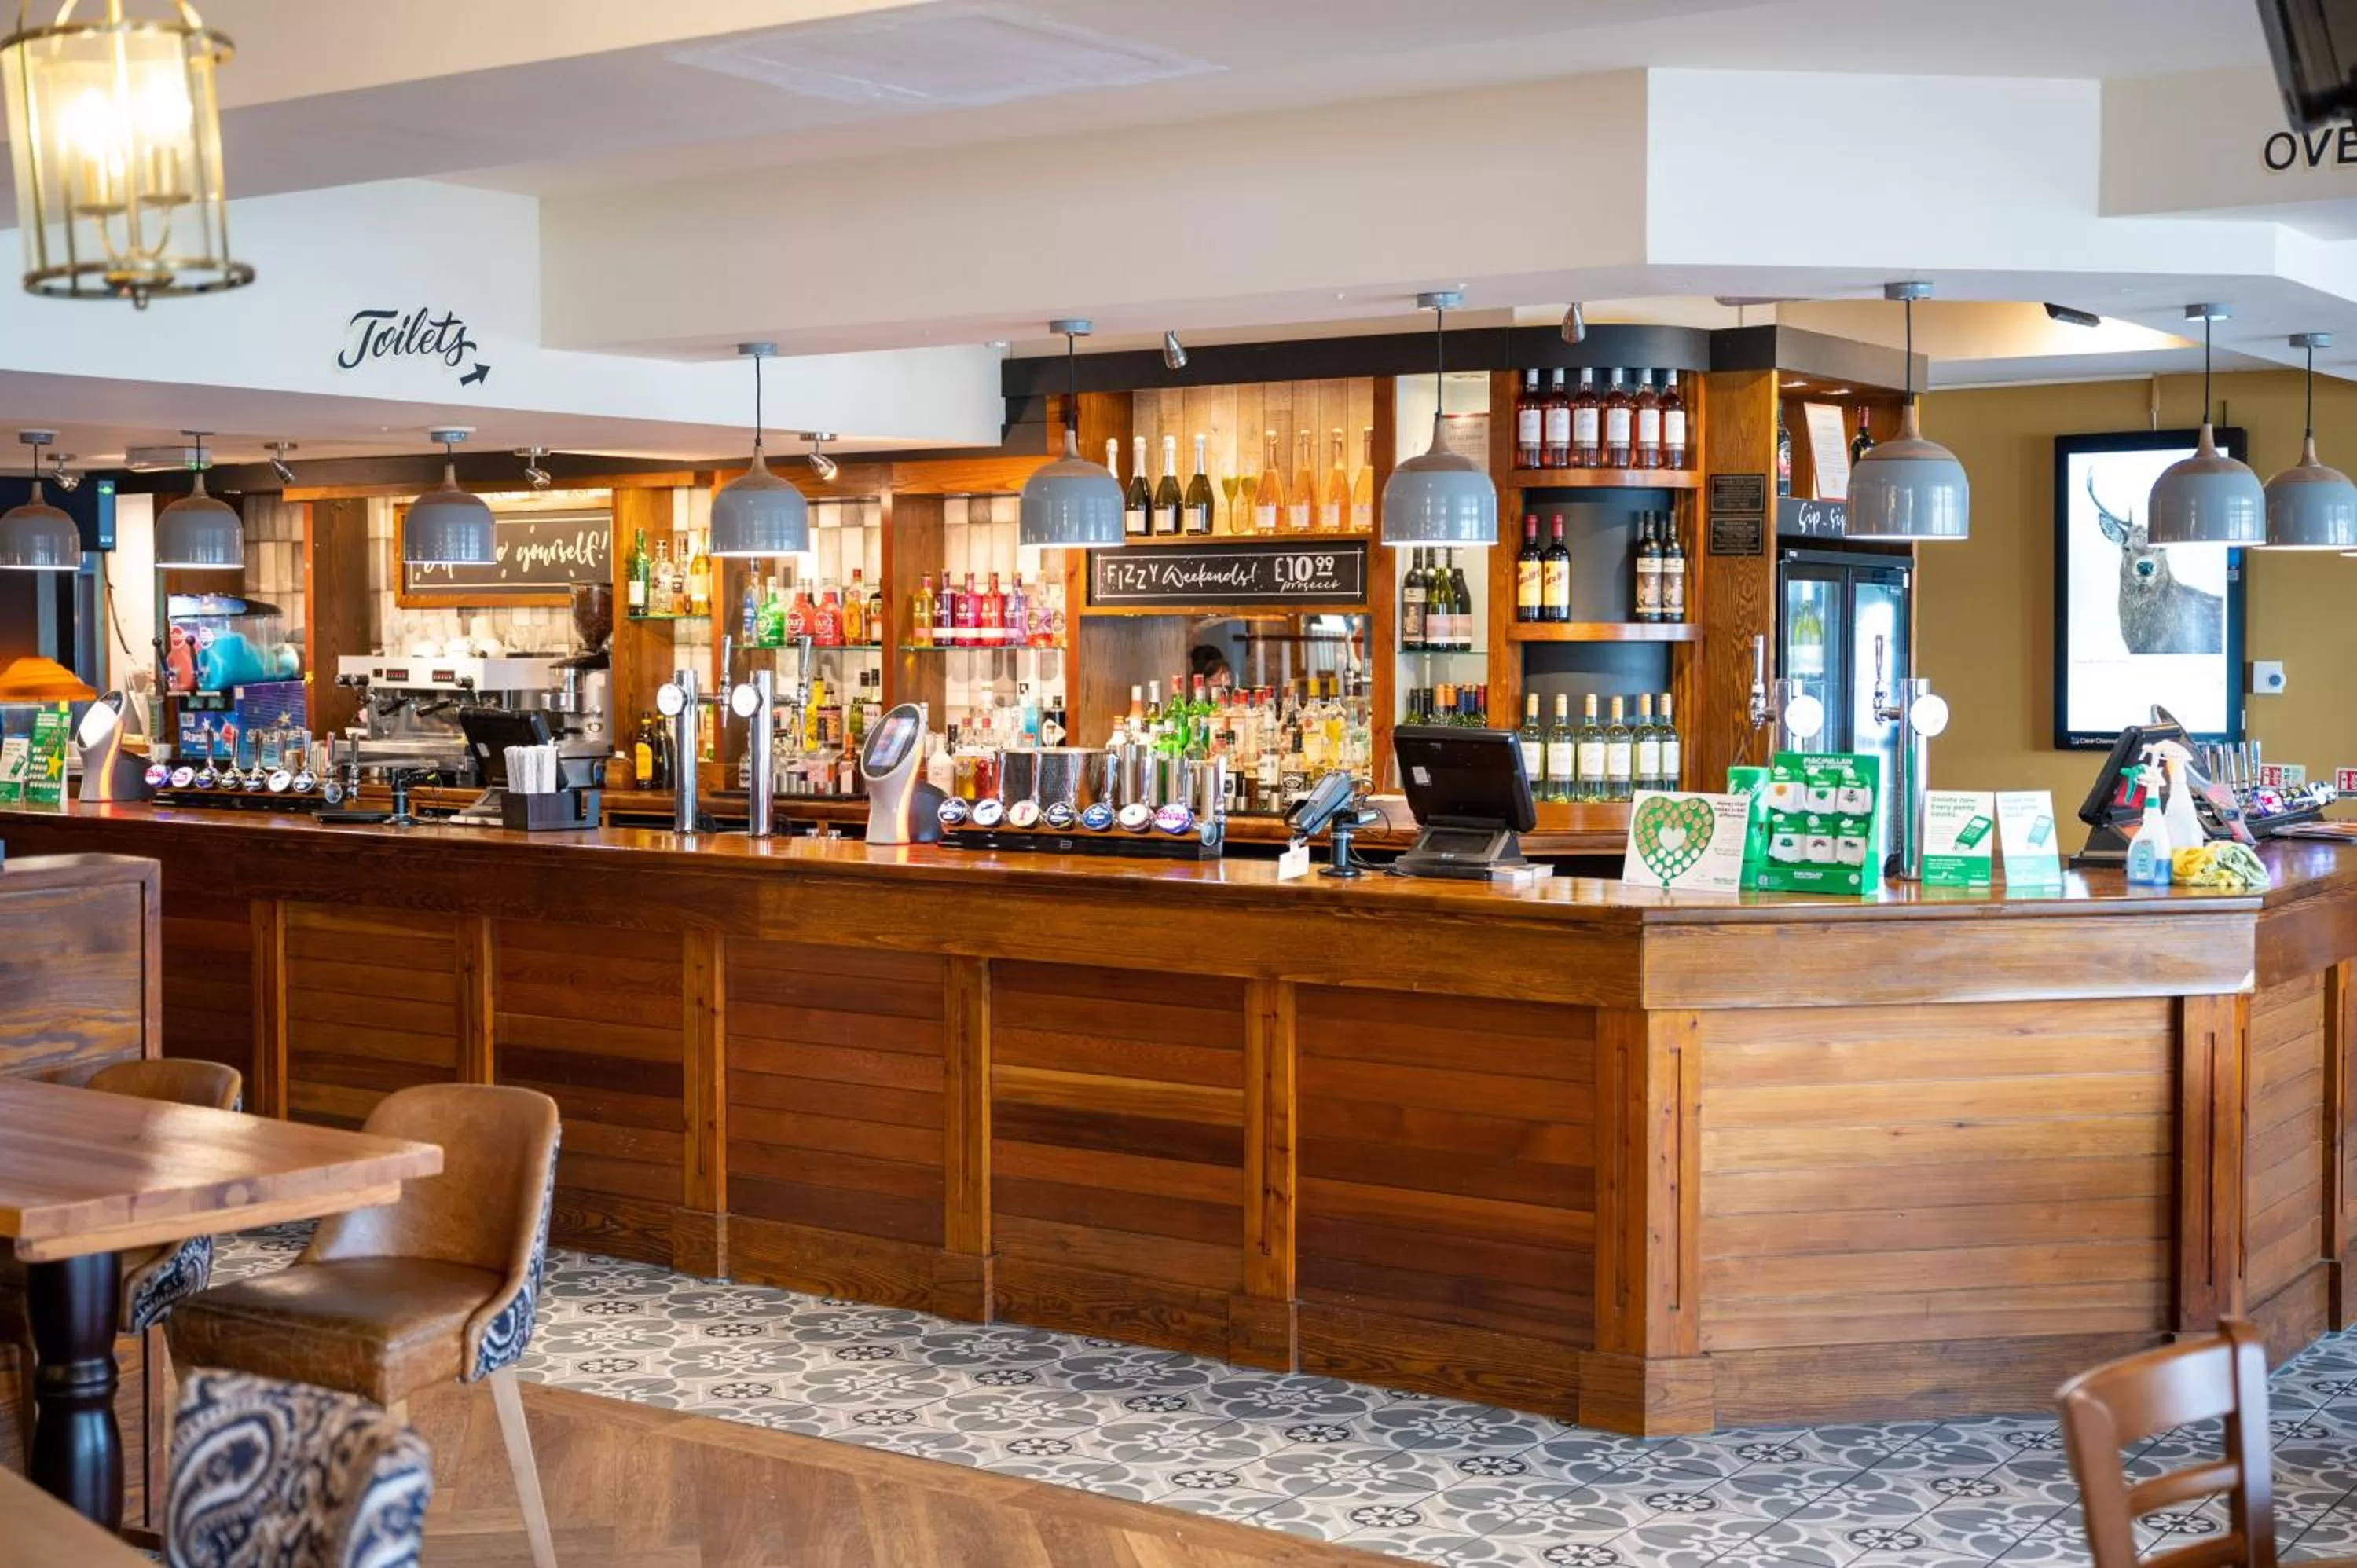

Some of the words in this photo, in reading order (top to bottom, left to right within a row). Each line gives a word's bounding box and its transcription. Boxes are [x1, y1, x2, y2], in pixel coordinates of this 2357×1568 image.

[338, 307, 477, 368] Toilets
[516, 530, 608, 573] yourself!
[1107, 563, 1159, 590] FIZZY
[1162, 562, 1257, 588] Weekends!
